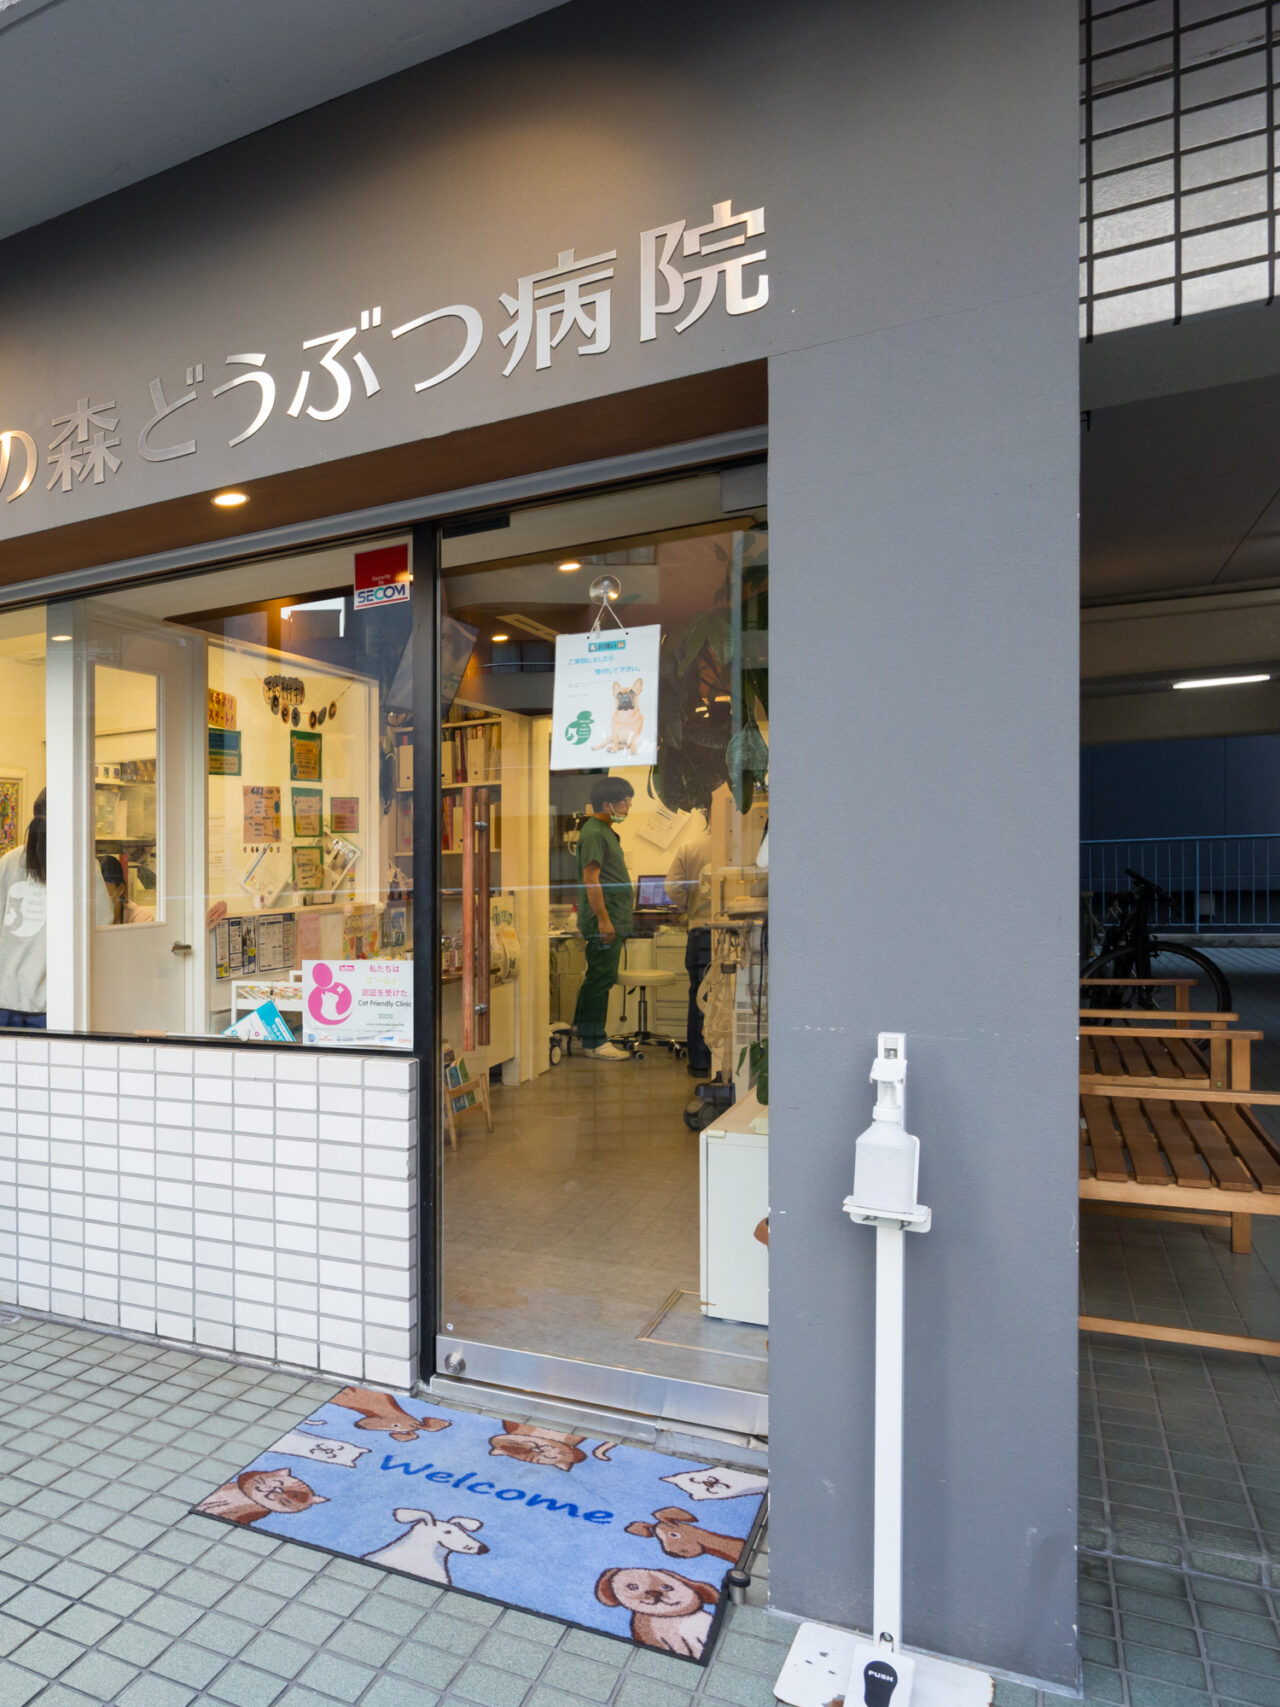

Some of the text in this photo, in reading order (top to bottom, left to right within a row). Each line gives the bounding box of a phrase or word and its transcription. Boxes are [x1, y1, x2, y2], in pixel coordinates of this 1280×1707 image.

[357, 584, 406, 604] SECOM
[369, 965, 400, 973] 私たちは
[370, 1000, 394, 1008] Friendly
[379, 1454, 615, 1525] Welcome
[867, 1669, 894, 1683] PUSH
